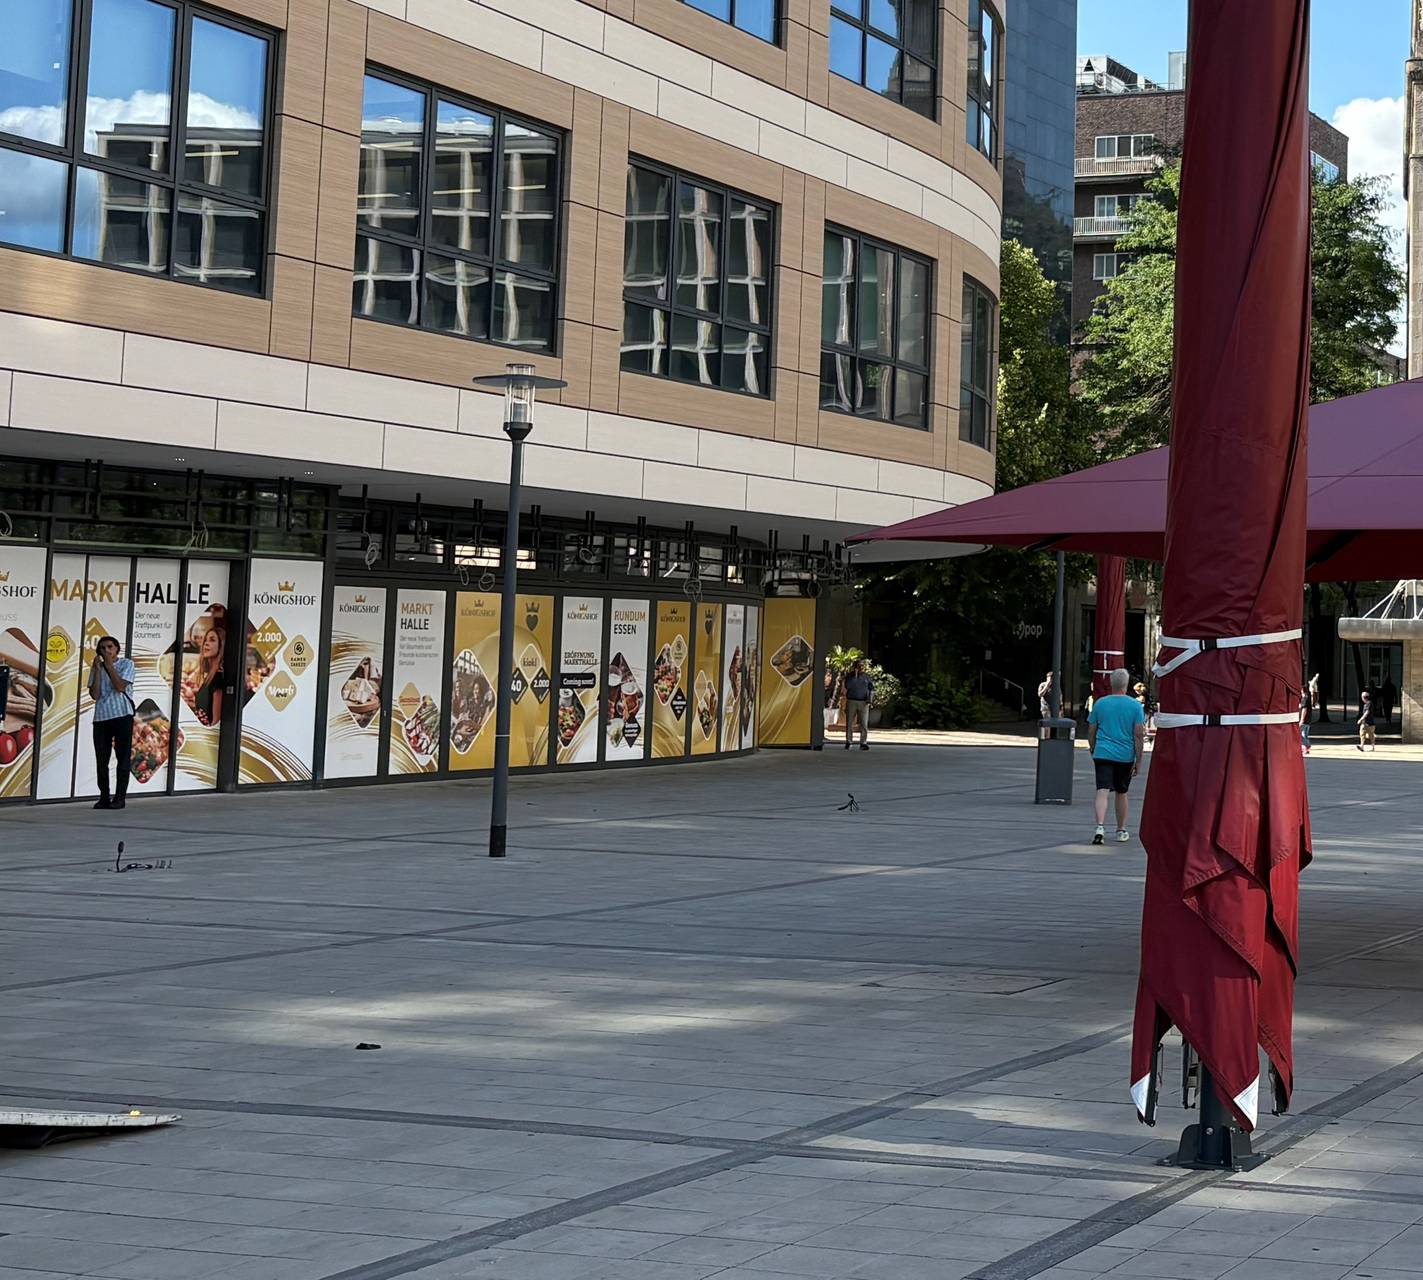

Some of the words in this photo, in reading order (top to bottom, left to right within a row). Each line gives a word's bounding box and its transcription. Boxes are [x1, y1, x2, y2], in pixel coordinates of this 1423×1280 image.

[0, 585, 38, 598] SHOF
[51, 578, 128, 603] MARKT
[135, 582, 210, 604] HALLE
[254, 592, 317, 606] KÖNIGSHOF
[339, 602, 381, 614] KÖNIGSHOF
[401, 603, 434, 615] MARKT
[614, 610, 646, 622] RUNDUM
[400, 618, 430, 630] HALLE
[613, 624, 637, 634] ESSEN
[256, 632, 282, 643] 2.000
[564, 650, 595, 659] ERÖFFNUNG
[511, 680, 522, 692] 40
